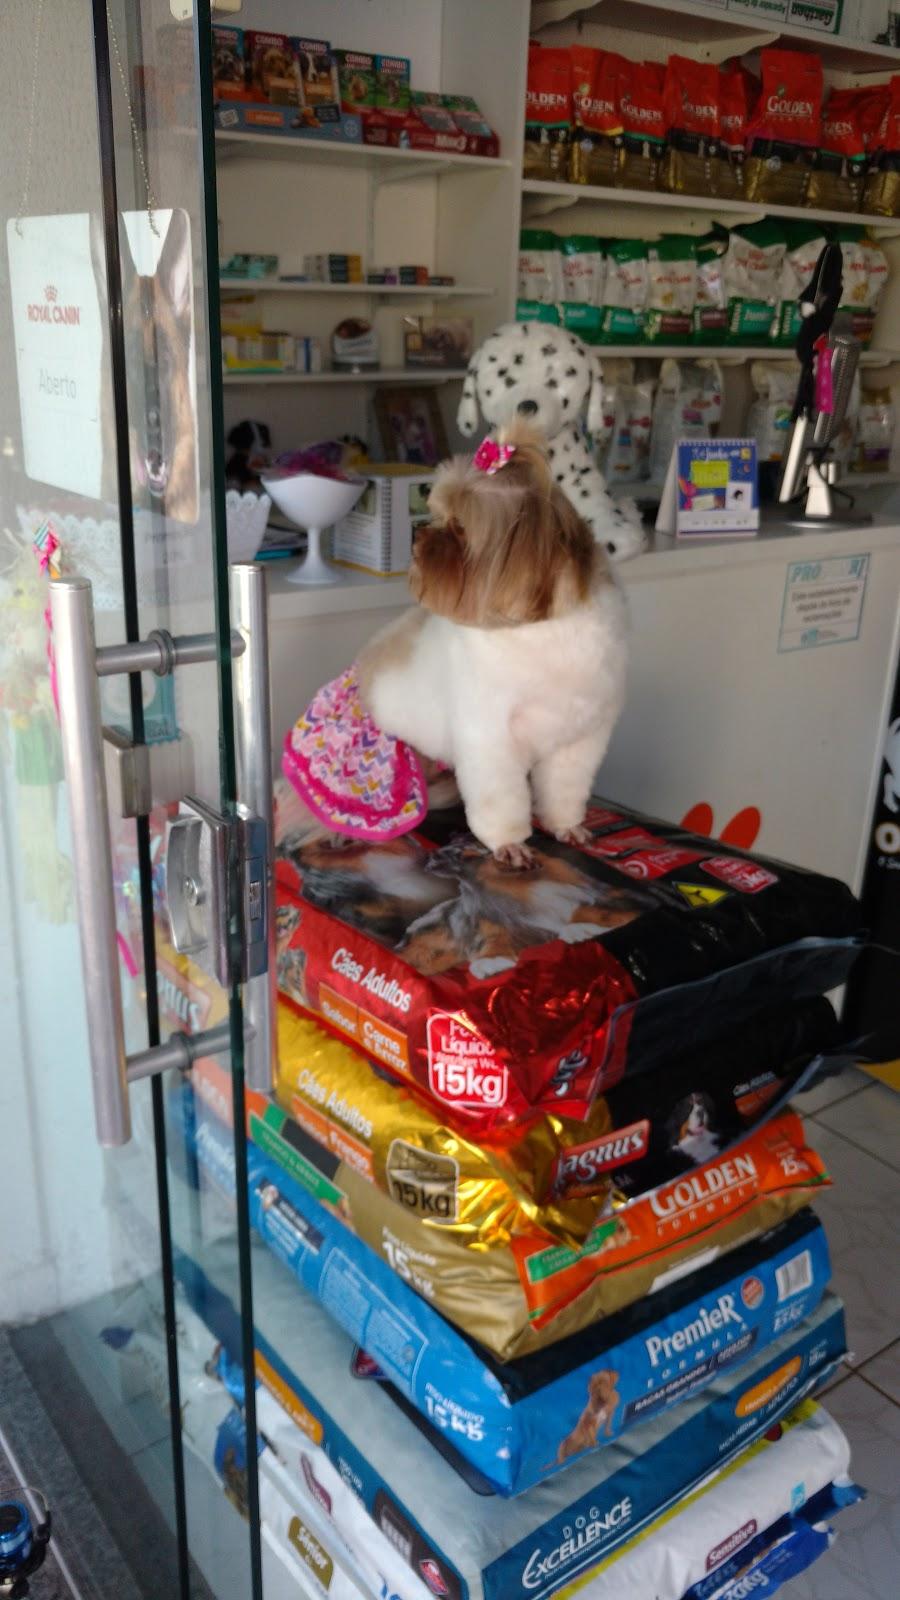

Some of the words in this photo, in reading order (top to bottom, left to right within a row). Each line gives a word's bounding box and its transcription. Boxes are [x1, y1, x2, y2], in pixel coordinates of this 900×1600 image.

[767, 95, 813, 117] GOLDEN
[28, 303, 53, 325] ROYAL
[53, 305, 80, 326] CANIN
[39, 368, 77, 400] Aberto
[331, 947, 362, 982] Cães
[360, 968, 413, 1013] Adultos
[433, 1062, 503, 1104] 15kg
[297, 1068, 326, 1106] Cães
[325, 1091, 374, 1139] Adultos
[393, 1179, 451, 1218] 15kg
[649, 1153, 757, 1218] GOLDEN
[521, 1496, 633, 1590] EXCELLENCE
[562, 1506, 601, 1540] DOG
